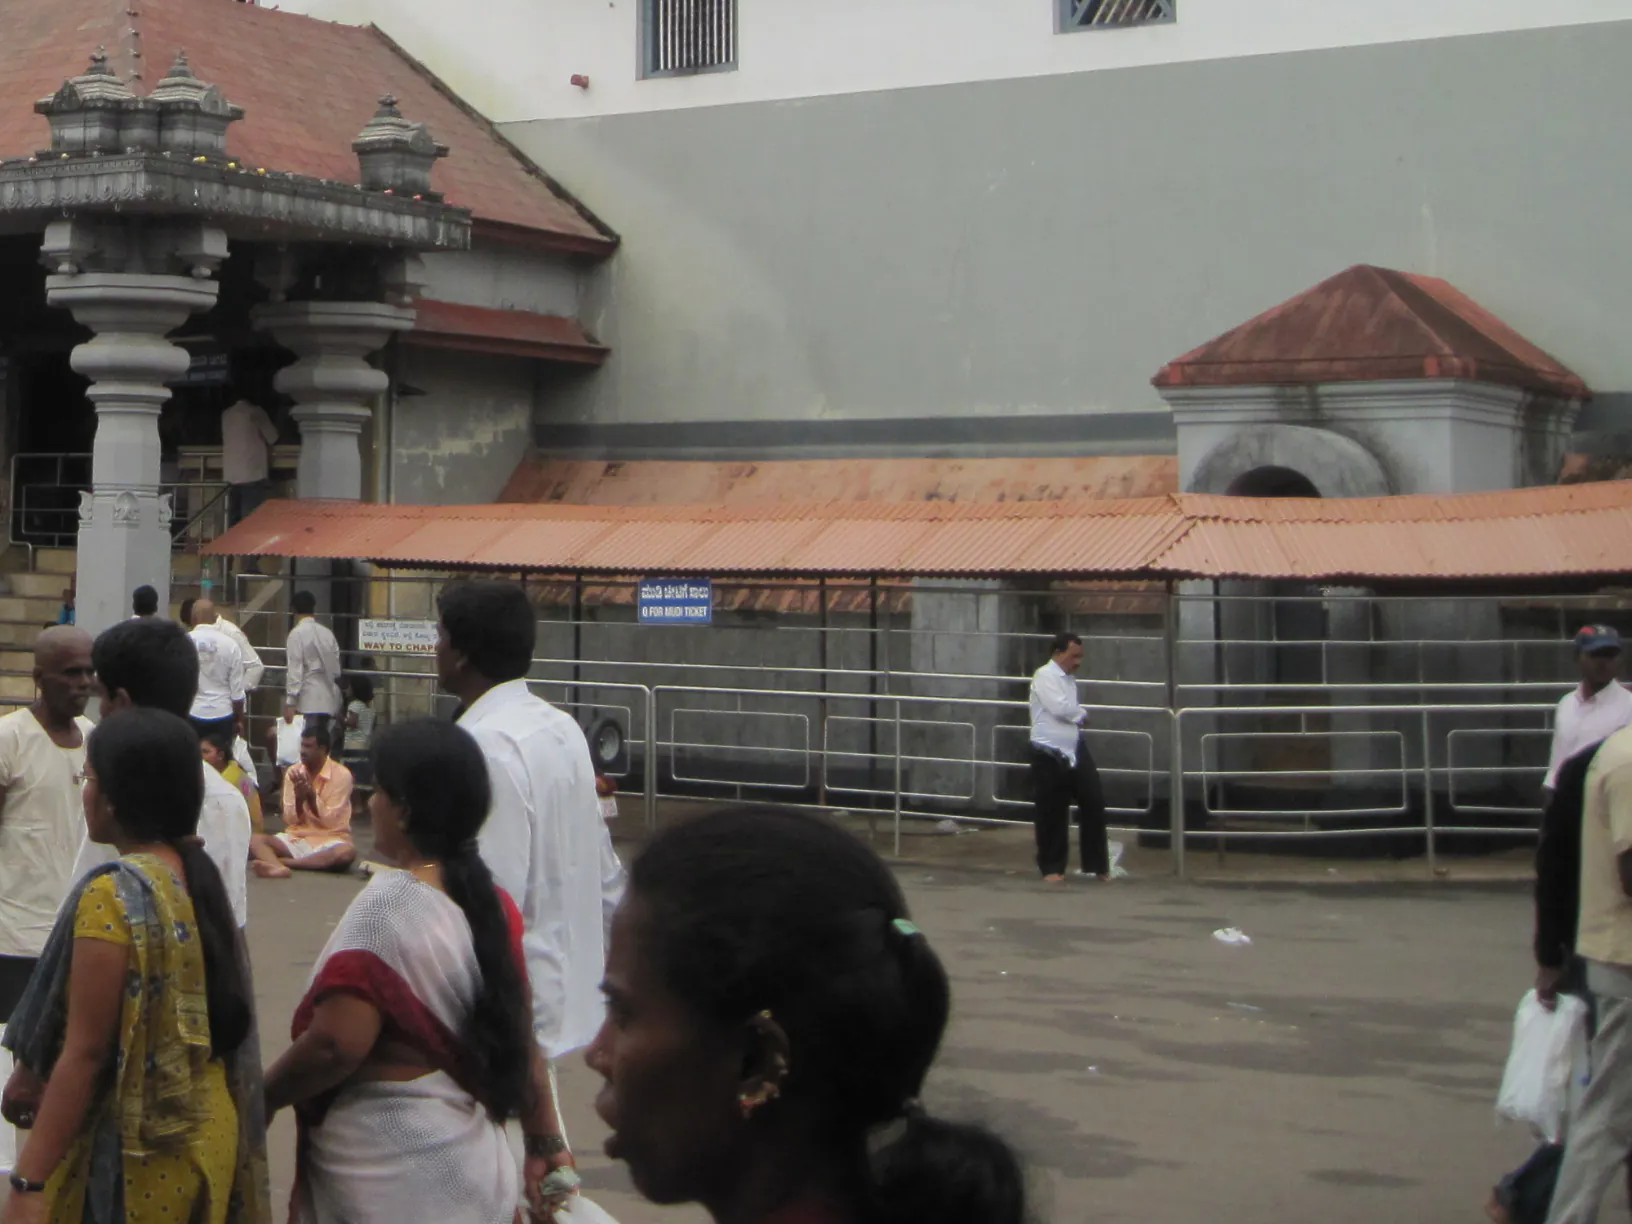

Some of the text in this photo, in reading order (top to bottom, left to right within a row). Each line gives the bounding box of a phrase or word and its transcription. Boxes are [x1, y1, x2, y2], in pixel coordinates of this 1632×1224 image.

[649, 606, 664, 617] FOR
[664, 606, 683, 617] MUDI
[684, 606, 708, 617] TICKET
[363, 642, 385, 650] WAY
[389, 642, 403, 650] TO
